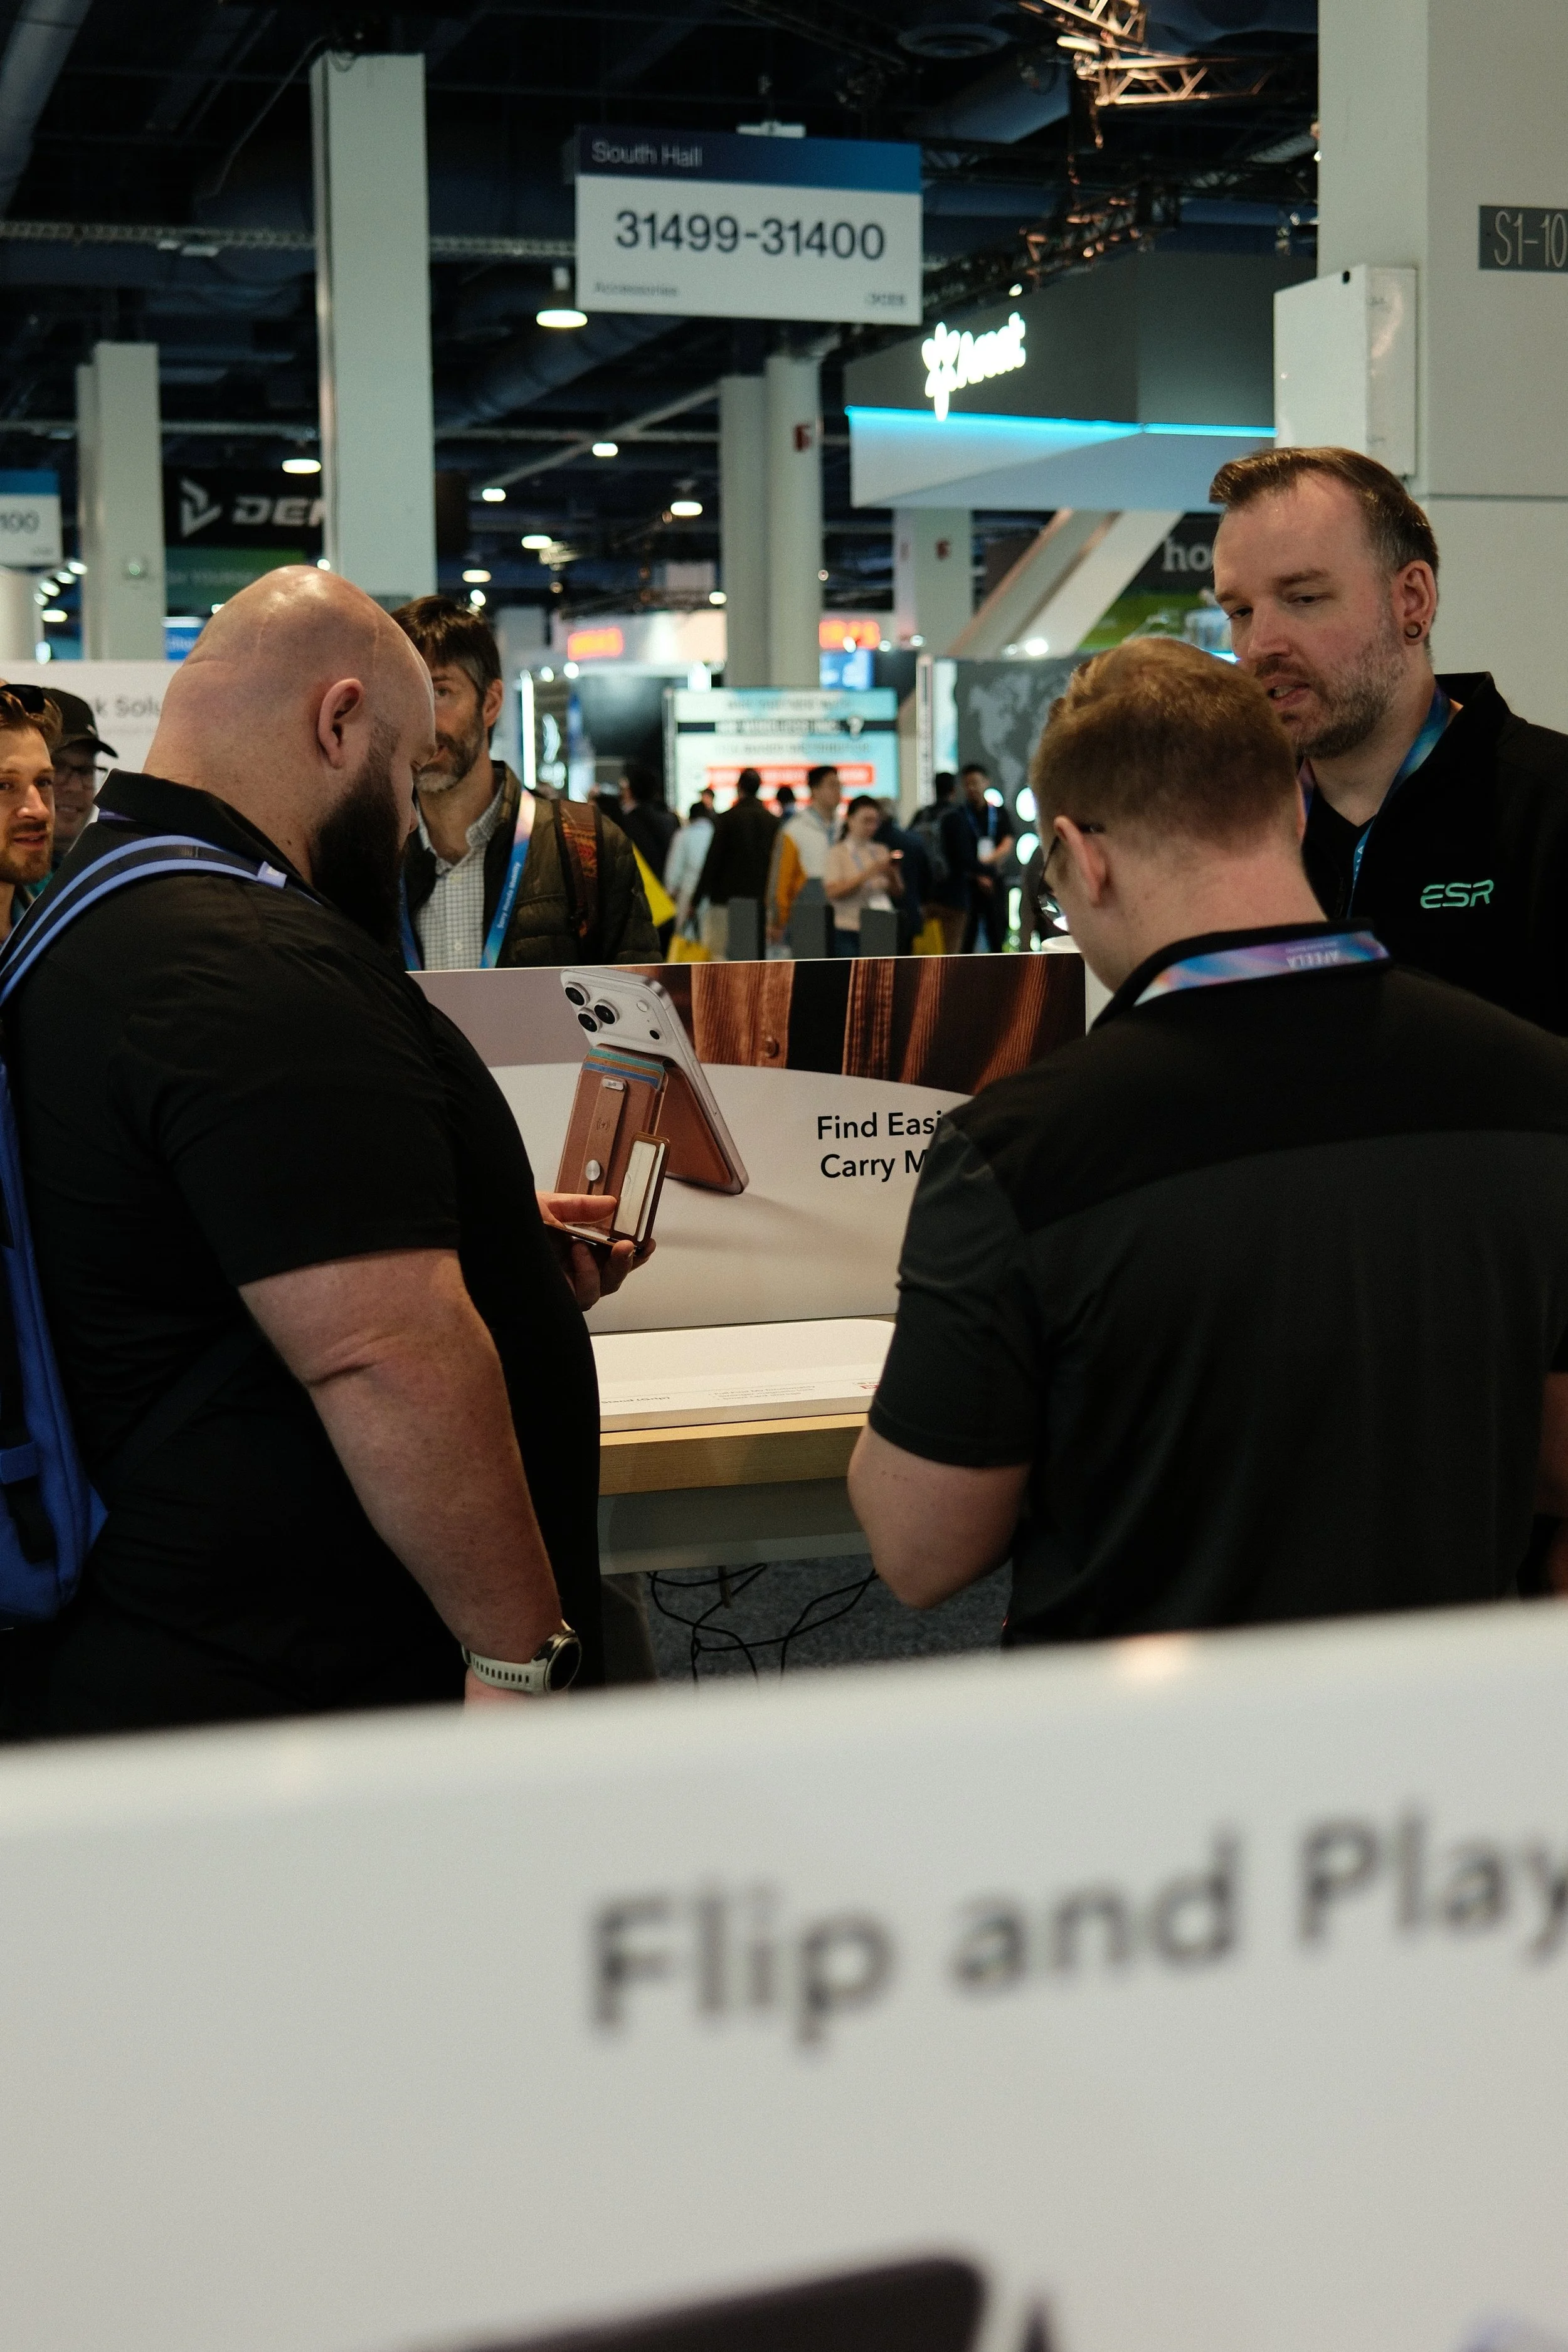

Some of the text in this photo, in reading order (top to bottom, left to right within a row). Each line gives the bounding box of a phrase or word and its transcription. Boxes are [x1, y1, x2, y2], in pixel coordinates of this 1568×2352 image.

[592, 141, 702, 168] South Hall
[615, 210, 885, 260] 31499-31400
[1493, 210, 1568, 268] S1-10
[1420, 879, 1494, 909] ESR
[817, 1111, 877, 1140] Find
[820, 1153, 896, 1183] Carry
[590, 1882, 898, 2056] Flip
[951, 1819, 1243, 1996] and
